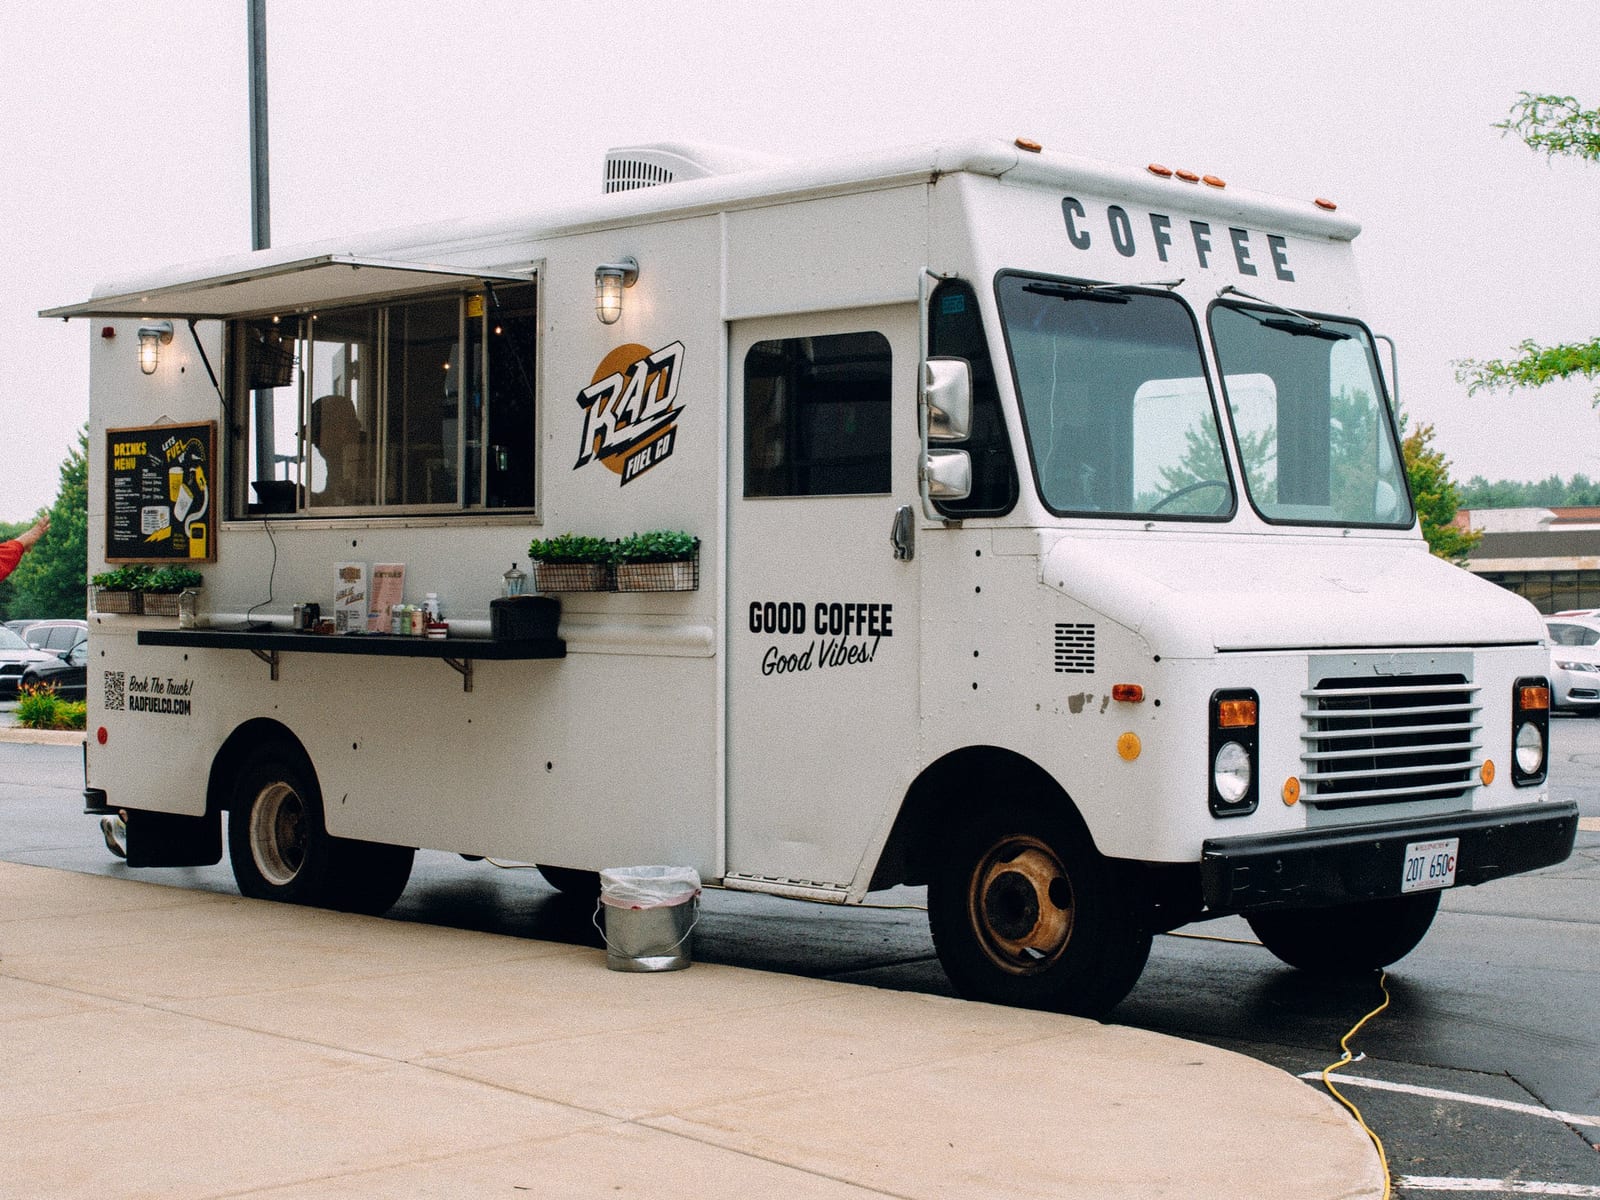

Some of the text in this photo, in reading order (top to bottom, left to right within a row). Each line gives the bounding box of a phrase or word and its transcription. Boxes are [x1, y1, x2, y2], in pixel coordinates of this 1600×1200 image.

[1061, 196, 1296, 283] COFFEE
[574, 340, 686, 470] RAD
[114, 441, 147, 457] DRINKS
[166, 439, 187, 462] FUEL
[625, 433, 671, 480] FUEL CO
[114, 457, 136, 470] MENU
[750, 601, 893, 637] GOOD COFFEE
[762, 633, 881, 676] Good Vibes!
[129, 675, 194, 696] Book The Truck!
[129, 695, 191, 716] RADFUELCO.COM
[1406, 856, 1425, 882] 207
